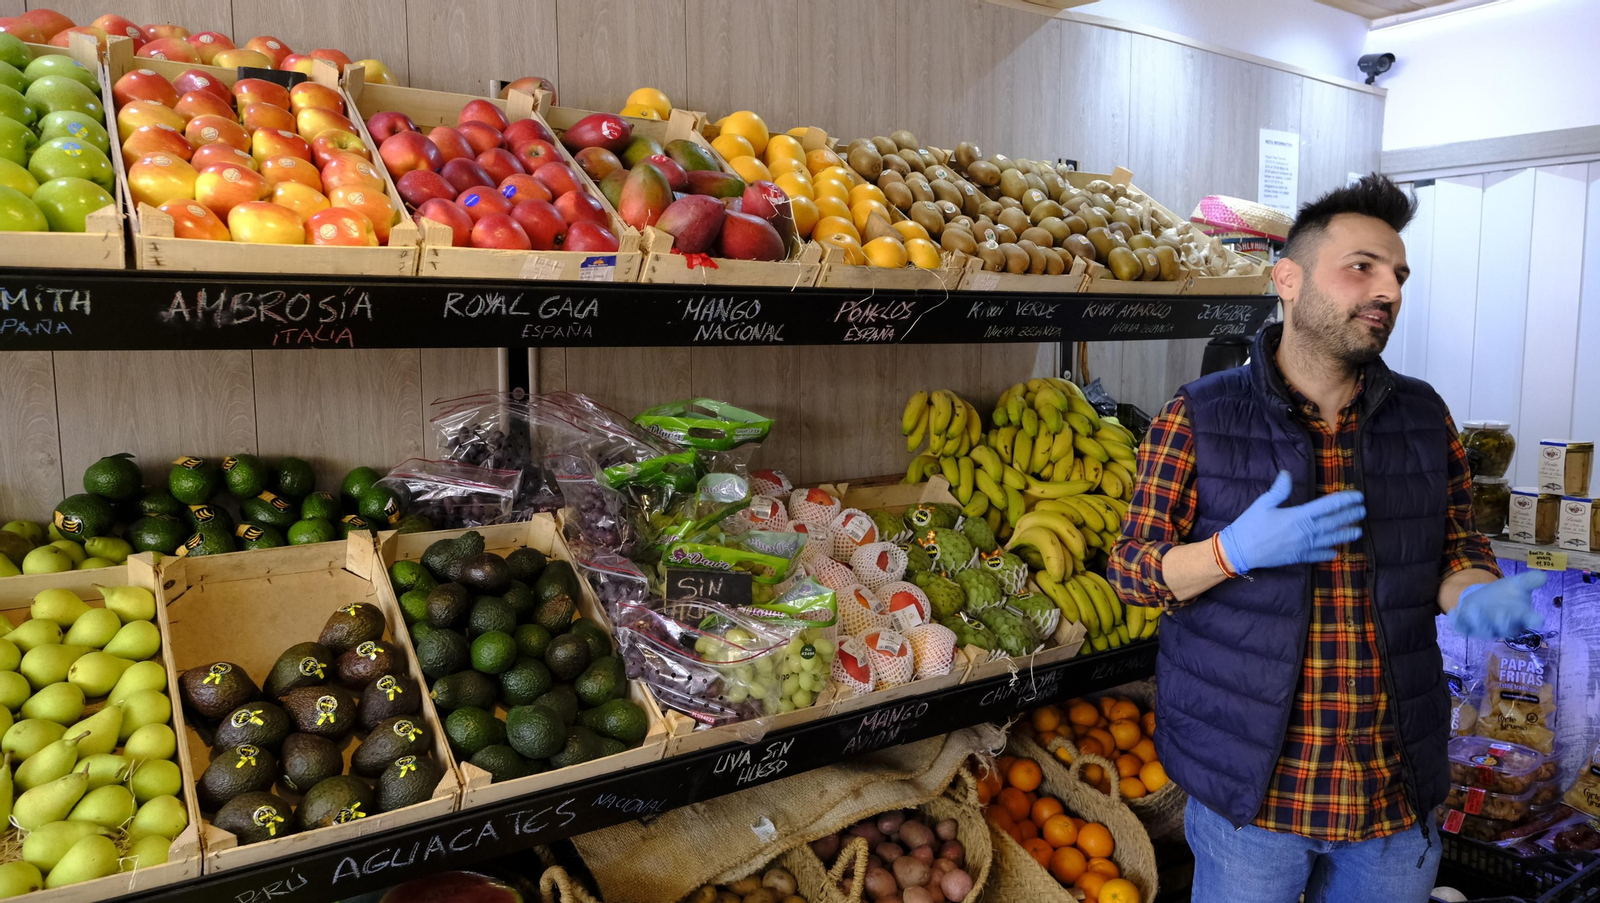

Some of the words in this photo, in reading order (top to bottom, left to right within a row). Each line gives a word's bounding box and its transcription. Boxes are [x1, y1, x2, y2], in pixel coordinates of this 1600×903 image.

[0, 285, 91, 316] MITH
[443, 292, 531, 319] ROYAL
[538, 294, 600, 320] GALA
[682, 296, 762, 322] MANGO
[1015, 299, 1061, 319] VERDE
[273, 326, 355, 348] ITALIA
[521, 321, 593, 339] ESPAÑA
[843, 324, 896, 342] ESPAÑA
[689, 551, 731, 570] Dania
[1501, 658, 1544, 674] PAPAS
[1500, 670, 1544, 687] FRITAS
[857, 701, 929, 733] MANGO
[713, 751, 752, 773] UVA
[736, 759, 789, 786] HUESO
[332, 798, 577, 885] AGUACATES
